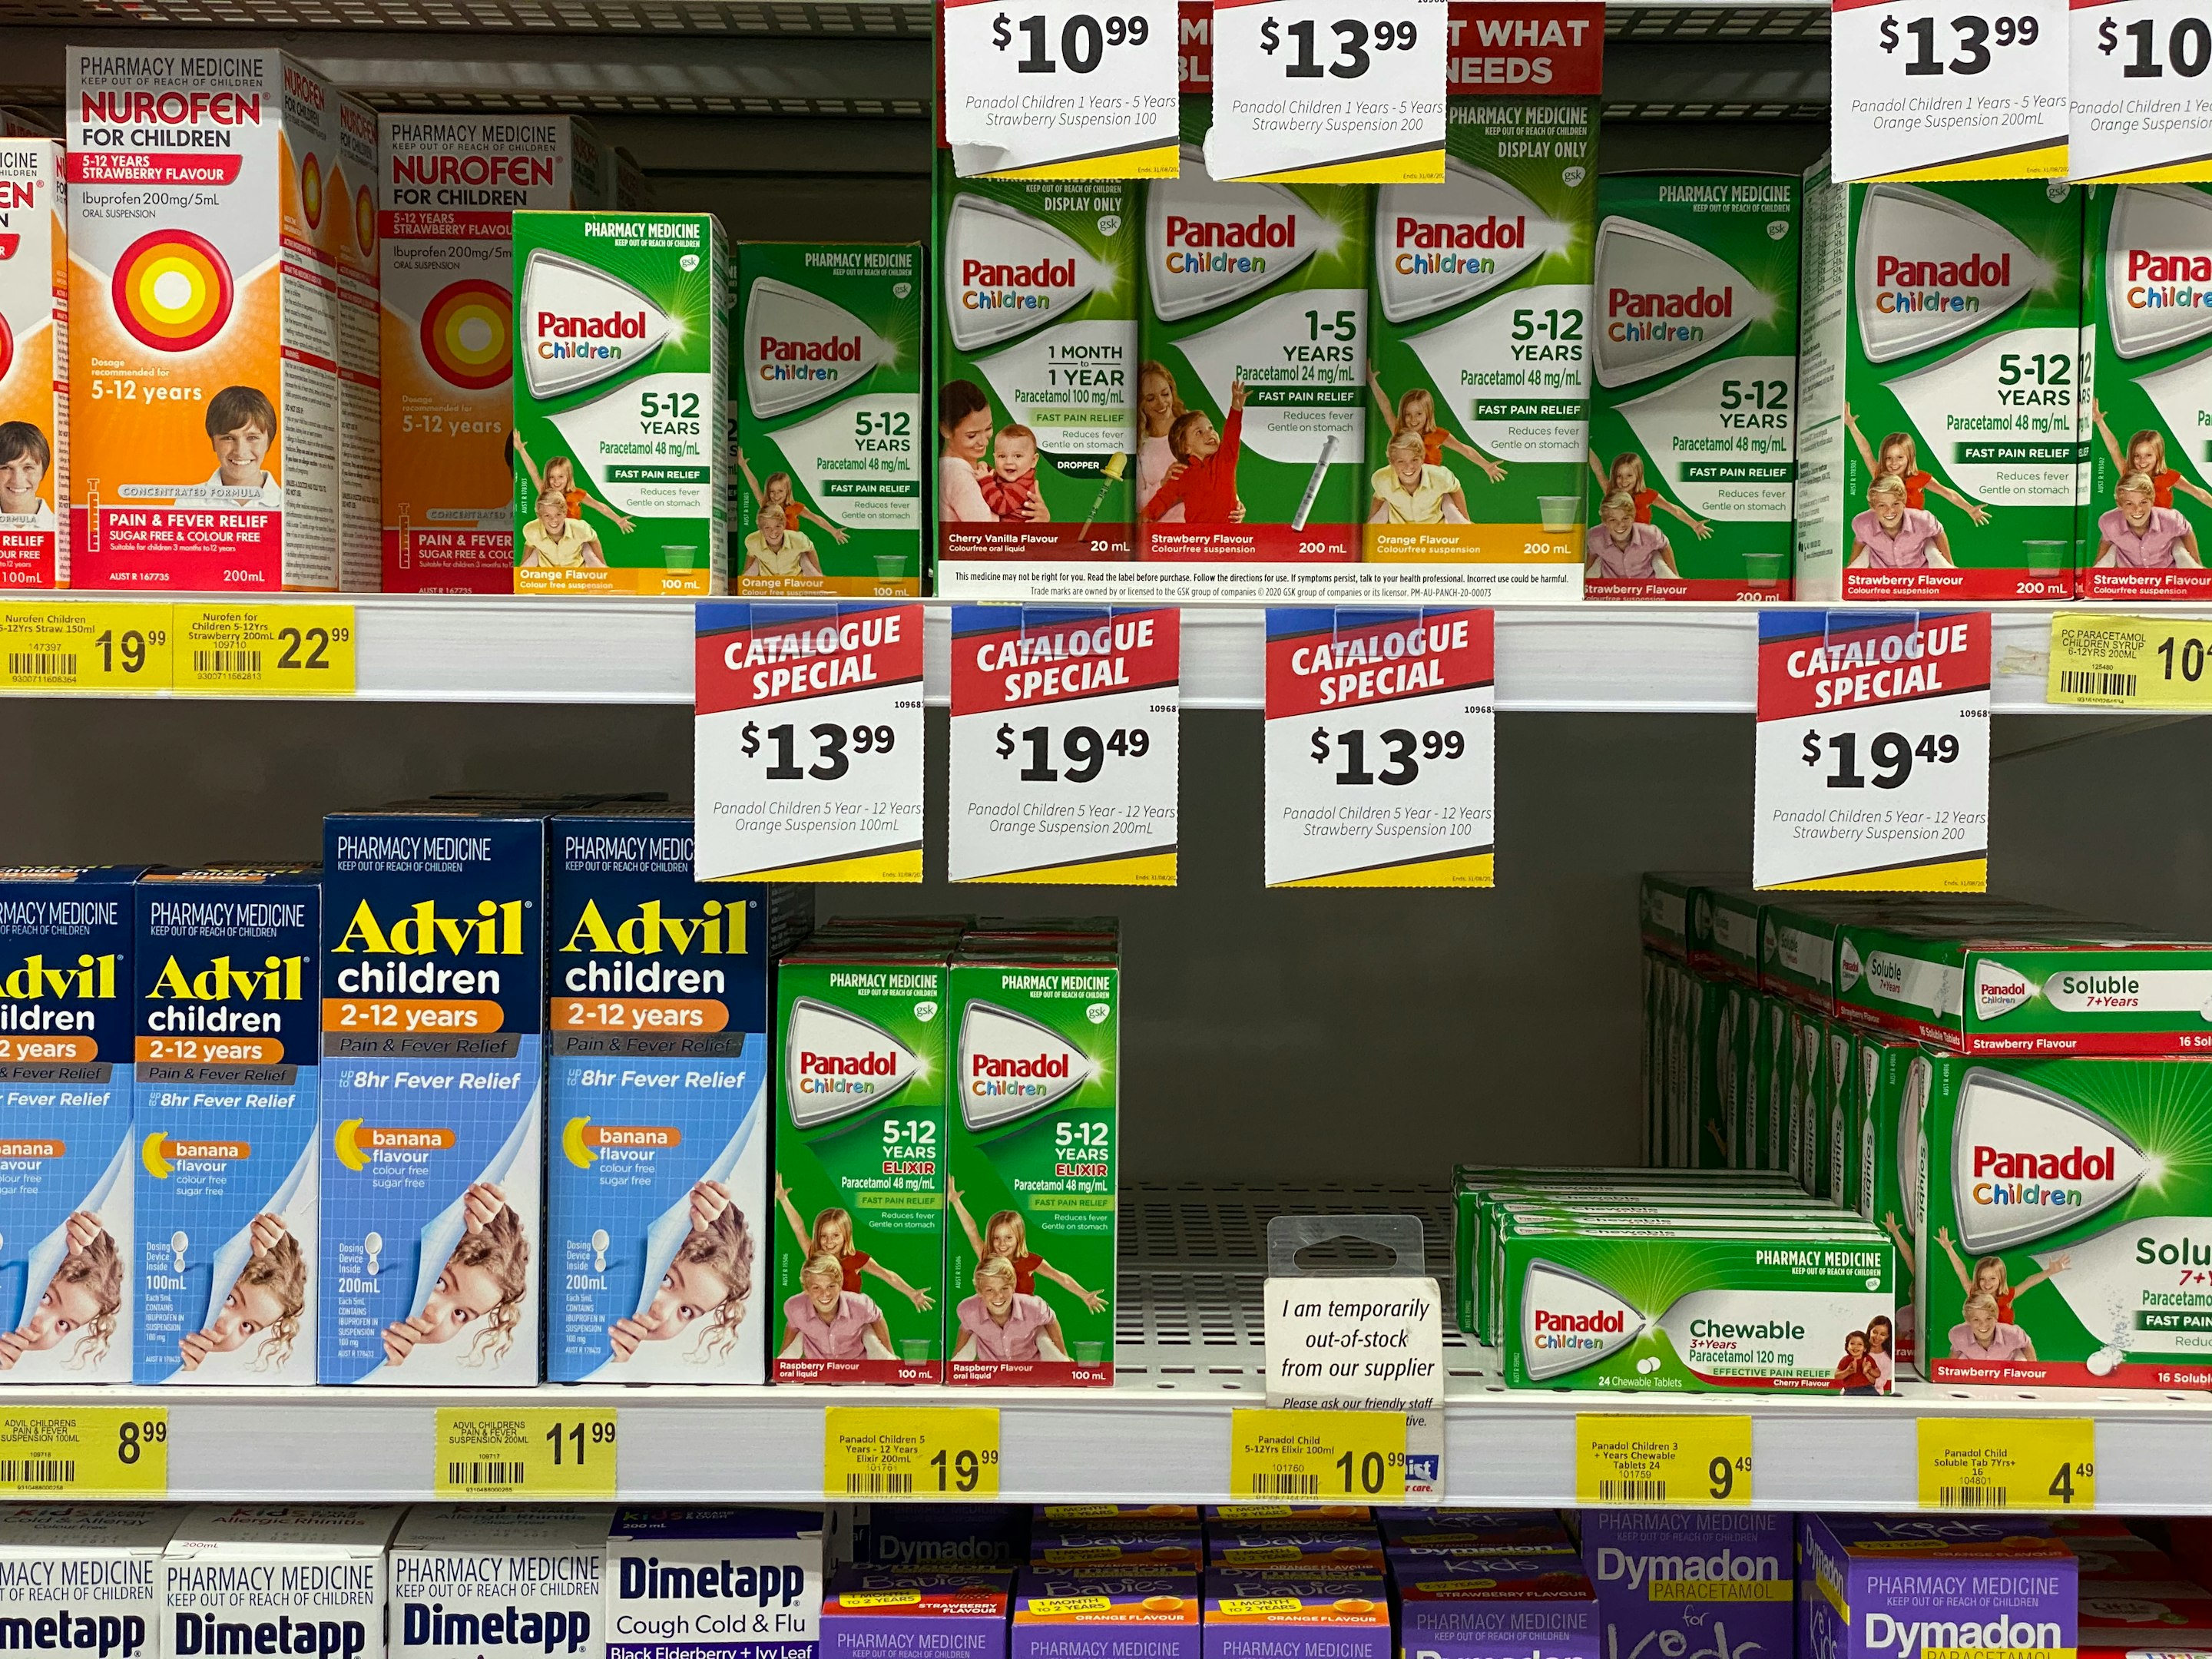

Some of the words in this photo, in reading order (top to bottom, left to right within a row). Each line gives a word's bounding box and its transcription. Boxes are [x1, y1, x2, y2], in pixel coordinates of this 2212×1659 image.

[81, 57, 174, 77] PHARMACY
[181, 58, 263, 78] MEDICINE
[1232, 99, 1286, 114] Panadol
[1288, 98, 1342, 114] Children
[1345, 100, 1351, 114] 1
[1355, 99, 1390, 114] Years
[1399, 101, 1407, 114] 5
[1409, 100, 1443, 114] Years
[1252, 118, 1321, 134] Strawberry
[1324, 117, 1397, 133] Suspension
[1400, 118, 1423, 131] 200
[82, 129, 125, 147] FOR
[131, 129, 230, 147] CHILDREN
[1498, 142, 1550, 158] DISPLAY
[1555, 142, 1588, 158] ONLY
[82, 167, 163, 180] STRAWBERRY
[166, 168, 224, 180] FLAVOUR
[82, 192, 141, 206] Ibuprofen
[143, 192, 220, 207] 200mg/5mL
[538, 310, 646, 339] Panadol
[538, 341, 621, 359] Children
[1048, 346, 1055, 359] 1
[1062, 346, 1122, 359] MONTH
[1080, 359, 1089, 368] to
[1049, 369, 1056, 385] 1
[1064, 369, 1124, 386] YEAR
[640, 392, 700, 419] 5-12
[641, 422, 700, 435] YEARS
[600, 442, 653, 455] Paracetamol
[655, 442, 667, 455] 48
[669, 441, 700, 457] mg/mL
[615, 470, 639, 478] FAST
[641, 471, 664, 479] PAIN
[667, 471, 700, 479] RELIEF
[641, 488, 675, 496] Reduces
[677, 488, 700, 496] fever
[627, 498, 651, 507] Gentle
[666, 499, 700, 508] stomach
[110, 514, 147, 527] PAIN
[152, 515, 164, 527] &
[167, 515, 215, 528] FEVER
[220, 515, 268, 528] RELIEF
[949, 534, 982, 545] Cherry
[985, 534, 1018, 543] Vanilla
[1021, 534, 1058, 543] Flavour
[1091, 540, 1108, 551] 20
[1112, 540, 1130, 551] mL
[224, 569, 265, 583] 200mL
[520, 569, 562, 582] Orange
[565, 570, 608, 580] Flavour
[955, 572, 969, 581] This
[970, 572, 999, 581] medicine
[1002, 575, 1015, 583] may
[1018, 573, 1029, 581] not
[1031, 572, 1039, 581] be
[1041, 572, 1056, 584] right
[1058, 572, 1068, 581] for
[1071, 575, 1085, 584] you.
[1848, 575, 1915, 588] Strawberry
[1918, 575, 1963, 586] Flavour
[661, 579, 680, 589] 100
[684, 580, 700, 589] mL
[244, 613, 257, 621] for
[192, 623, 231, 631] Children
[233, 623, 268, 631] 5-12Yrs
[189, 632, 240, 641] Strawberry
[2061, 630, 2075, 639] PC
[2077, 631, 2146, 642] PARACETAMOL
[976, 619, 1154, 672] CATALOGUE
[2062, 638, 2111, 649] CHILDREN
[2112, 640, 2144, 651] SYRUP
[2068, 647, 2106, 657] 6-12YRS
[2108, 649, 2137, 659] 200ML
[1004, 657, 1130, 703] SPECIAL
[968, 802, 1021, 817] Panadol
[1023, 802, 1075, 818] Children
[1078, 804, 1085, 817] 5
[1088, 803, 1115, 818] Year
[1126, 805, 1141, 818] 12
[1143, 805, 1176, 819] Years
[989, 820, 1035, 836] Orange
[1038, 820, 1110, 836] Suspension
[1113, 821, 1153, 835] 200mL
[337, 961, 500, 995] children
[2062, 976, 2140, 994] Soluble
[2086, 995, 2139, 1008] 7+Years
[340, 1005, 398, 1026] 2-12
[406, 1007, 478, 1031] years
[339, 1038, 378, 1052] Pain
[383, 1039, 395, 1052] &
[401, 1039, 452, 1053] Fever
[456, 1038, 508, 1054] Relief
[1973, 1038, 2034, 1051] Strawberry
[2036, 1038, 2078, 1049] Flavour
[373, 1131, 442, 1146] banana
[373, 1148, 429, 1163] flavour
[1974, 1145, 2115, 1181] Panadol
[882, 1162, 935, 1174] ELIXIR
[1972, 1183, 2081, 1206] Children
[1283, 1300, 1289, 1317] I
[1294, 1303, 1321, 1317] am
[1329, 1299, 1429, 1321] temporarily
[1535, 1310, 1624, 1333] Panadol
[1690, 1320, 1805, 1339] Chewable
[1306, 1330, 1408, 1347] out-of-stock
[1535, 1334, 1604, 1349] Children
[1690, 1339, 1737, 1350] 3+Years
[1690, 1349, 1753, 1363] Paracetamol
[1757, 1351, 1774, 1363] 120
[1777, 1354, 1793, 1366] mg
[780, 1363, 825, 1371] Raspberry
[898, 1369, 916, 1378] 100
[1282, 1359, 1322, 1377] from
[1330, 1362, 1359, 1376] our
[1365, 1359, 1435, 1380] supplier
[1598, 1377, 1610, 1386] 24
[1612, 1376, 1651, 1387] Chewable
[1654, 1377, 1682, 1388] Tablets
[1258, 1435, 1295, 1445] Panadol
[1297, 1436, 1320, 1445] Child
[1282, 1445, 1303, 1454] Elixir
[1598, 1548, 1778, 1590] Dymadon
[167, 1567, 276, 1591] PHARMACY
[282, 1565, 373, 1589] MEDICINE
[619, 1557, 805, 1608] Dimetapp
[167, 1594, 197, 1606] KEEP
[200, 1594, 226, 1606] OUT
[230, 1593, 246, 1606] OF
[250, 1592, 290, 1605] REACH
[293, 1592, 310, 1605] OF
[313, 1591, 373, 1605] CHILDREN
[1654, 1584, 1774, 1599] PARACETAMOL
[617, 1616, 690, 1639] Cough
[697, 1615, 746, 1633] Cold
[752, 1615, 769, 1633] &
[775, 1614, 806, 1632] Flu
